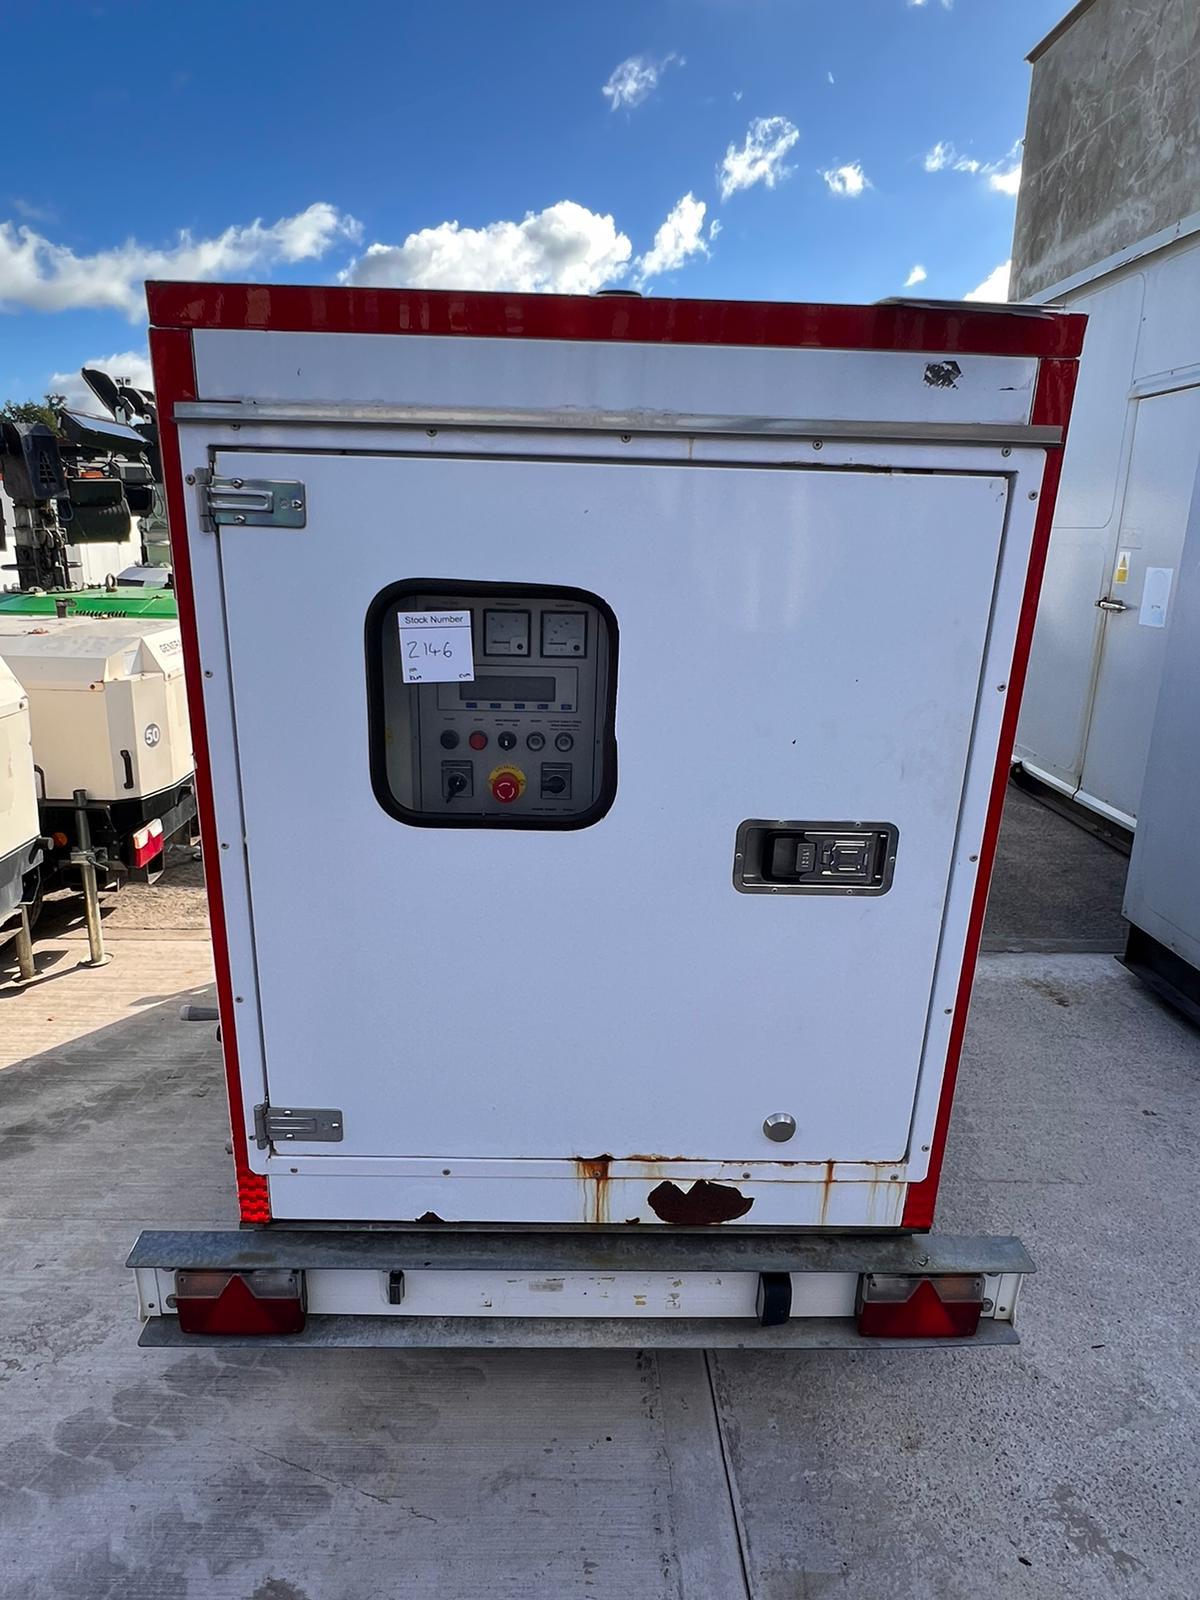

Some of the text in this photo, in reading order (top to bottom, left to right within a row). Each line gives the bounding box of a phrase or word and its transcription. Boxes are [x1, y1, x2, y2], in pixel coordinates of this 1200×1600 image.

[405, 615, 464, 624] Stock Number
[406, 640, 453, 659] 2146
[146, 728, 160, 745] 50
